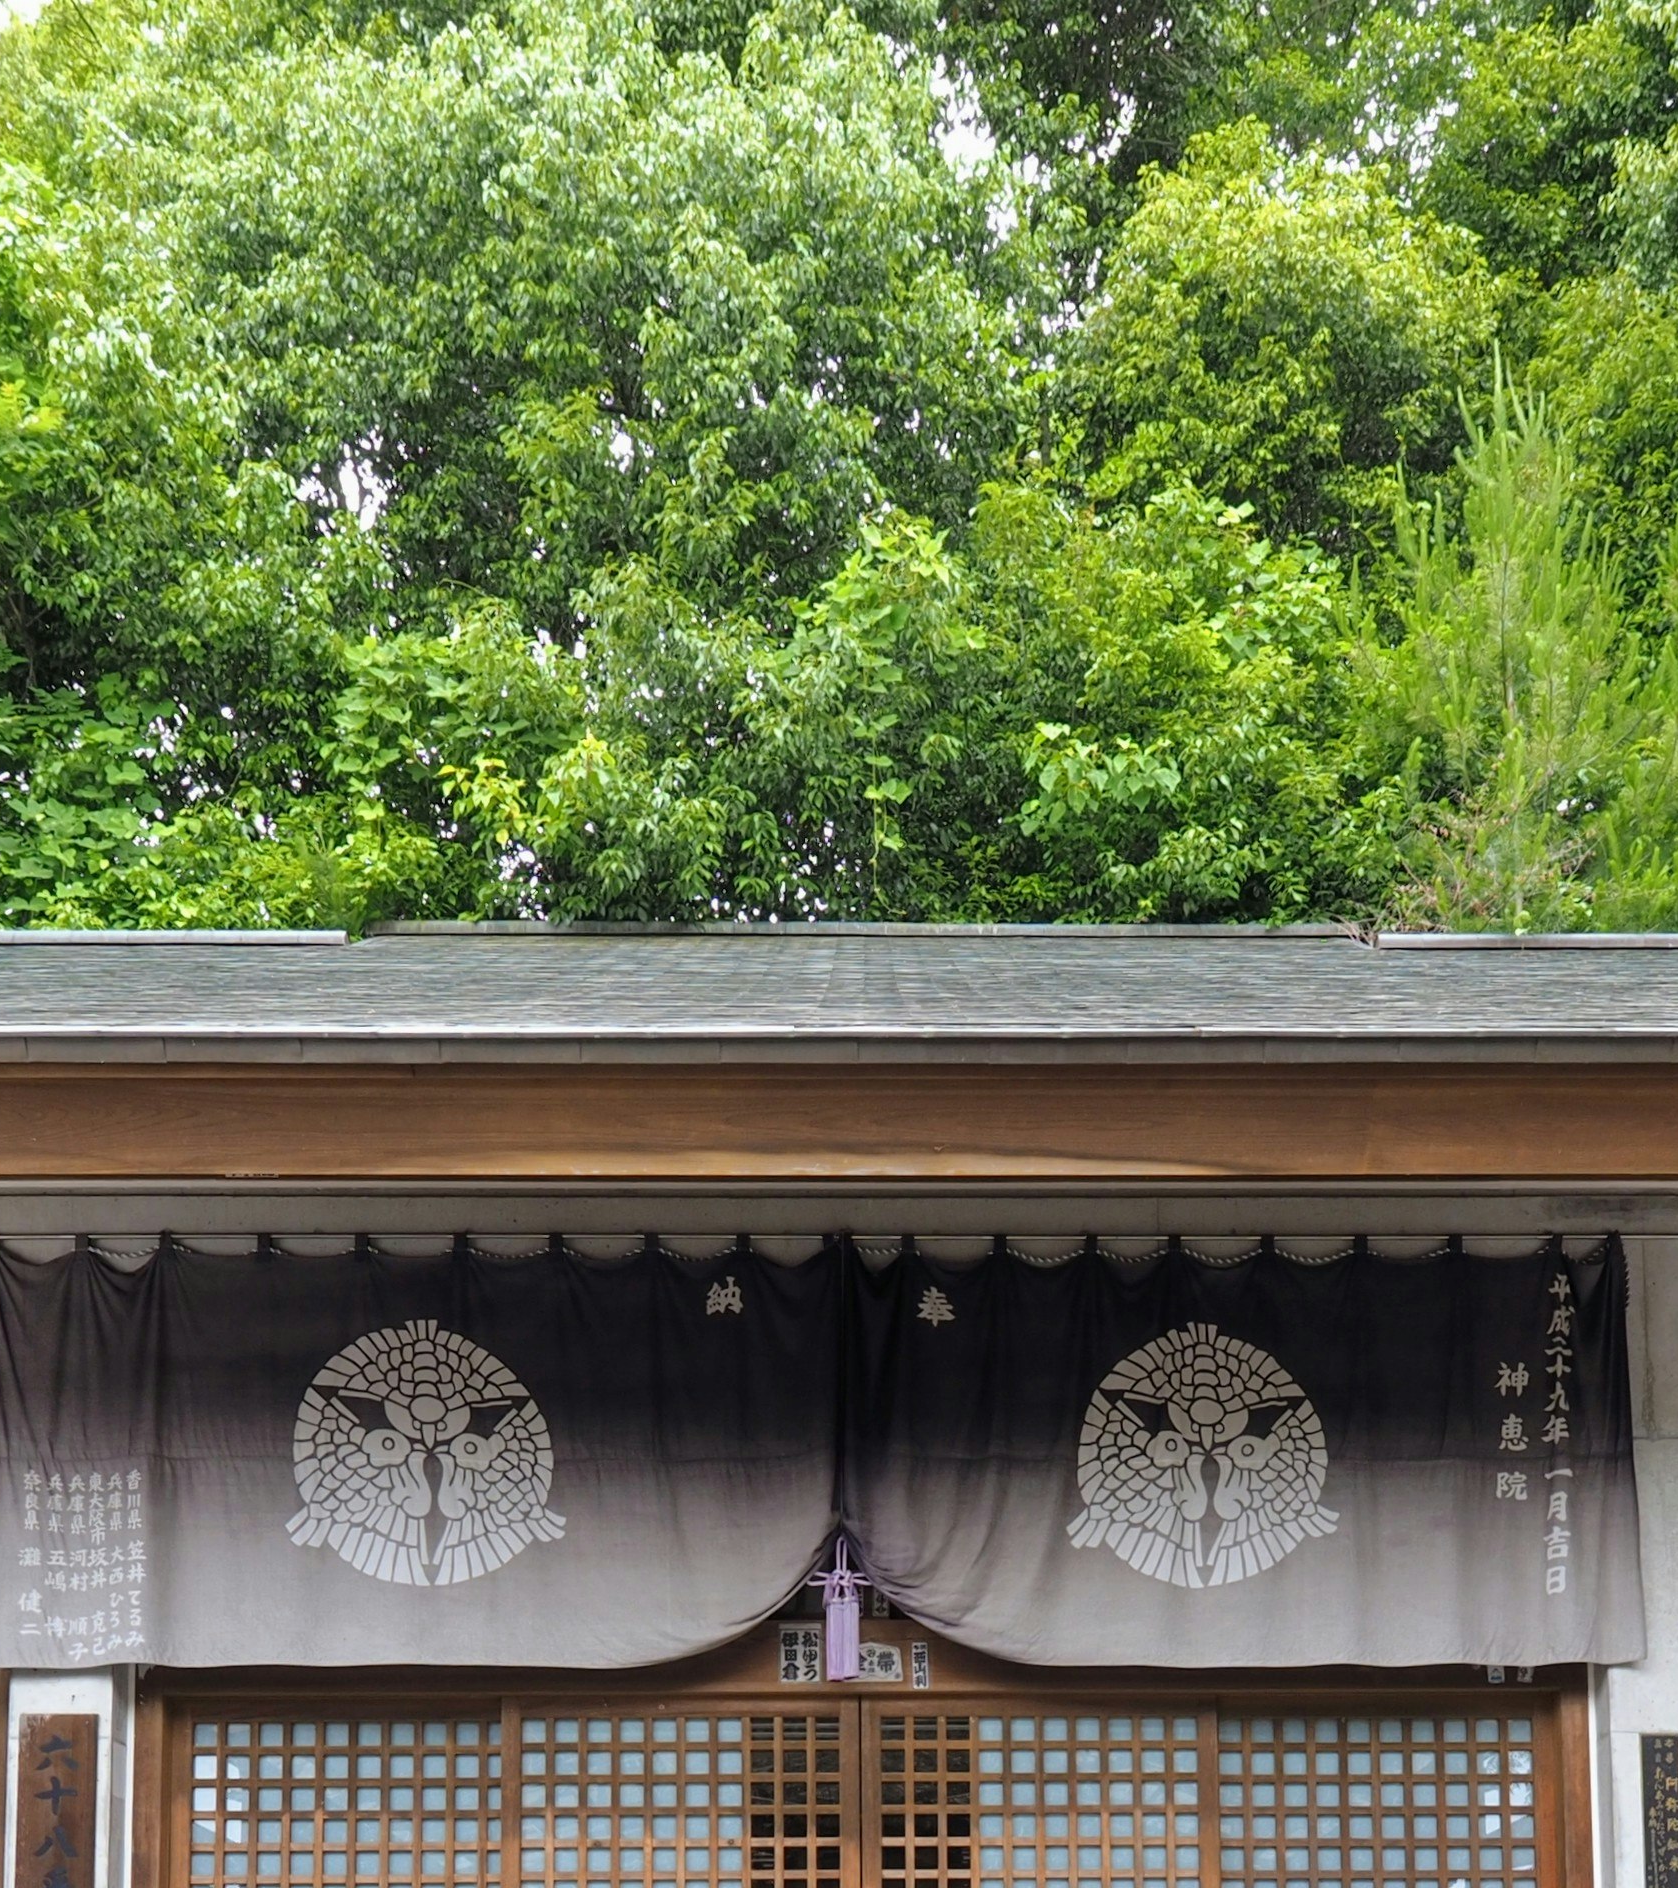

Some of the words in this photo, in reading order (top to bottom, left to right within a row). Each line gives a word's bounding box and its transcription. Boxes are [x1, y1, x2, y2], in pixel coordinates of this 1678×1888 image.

[706, 1276, 744, 1315] 納
[917, 1286, 956, 1327] 奉
[1541, 1273, 1576, 1444] 平成二十九年
[1494, 1361, 1529, 1500] 神恵院
[23, 1470, 42, 1531] 奈良県
[66, 1474, 86, 1534] 兵庫県
[89, 1472, 107, 1545] 東大阪市
[107, 1472, 123, 1531] 兵庫県
[125, 1469, 142, 1529] 香川県
[1543, 1468, 1574, 1595] 一月吉日
[69, 1549, 89, 1592] 河村
[87, 1548, 109, 1588] 坂井
[67, 1616, 88, 1661] 順子
